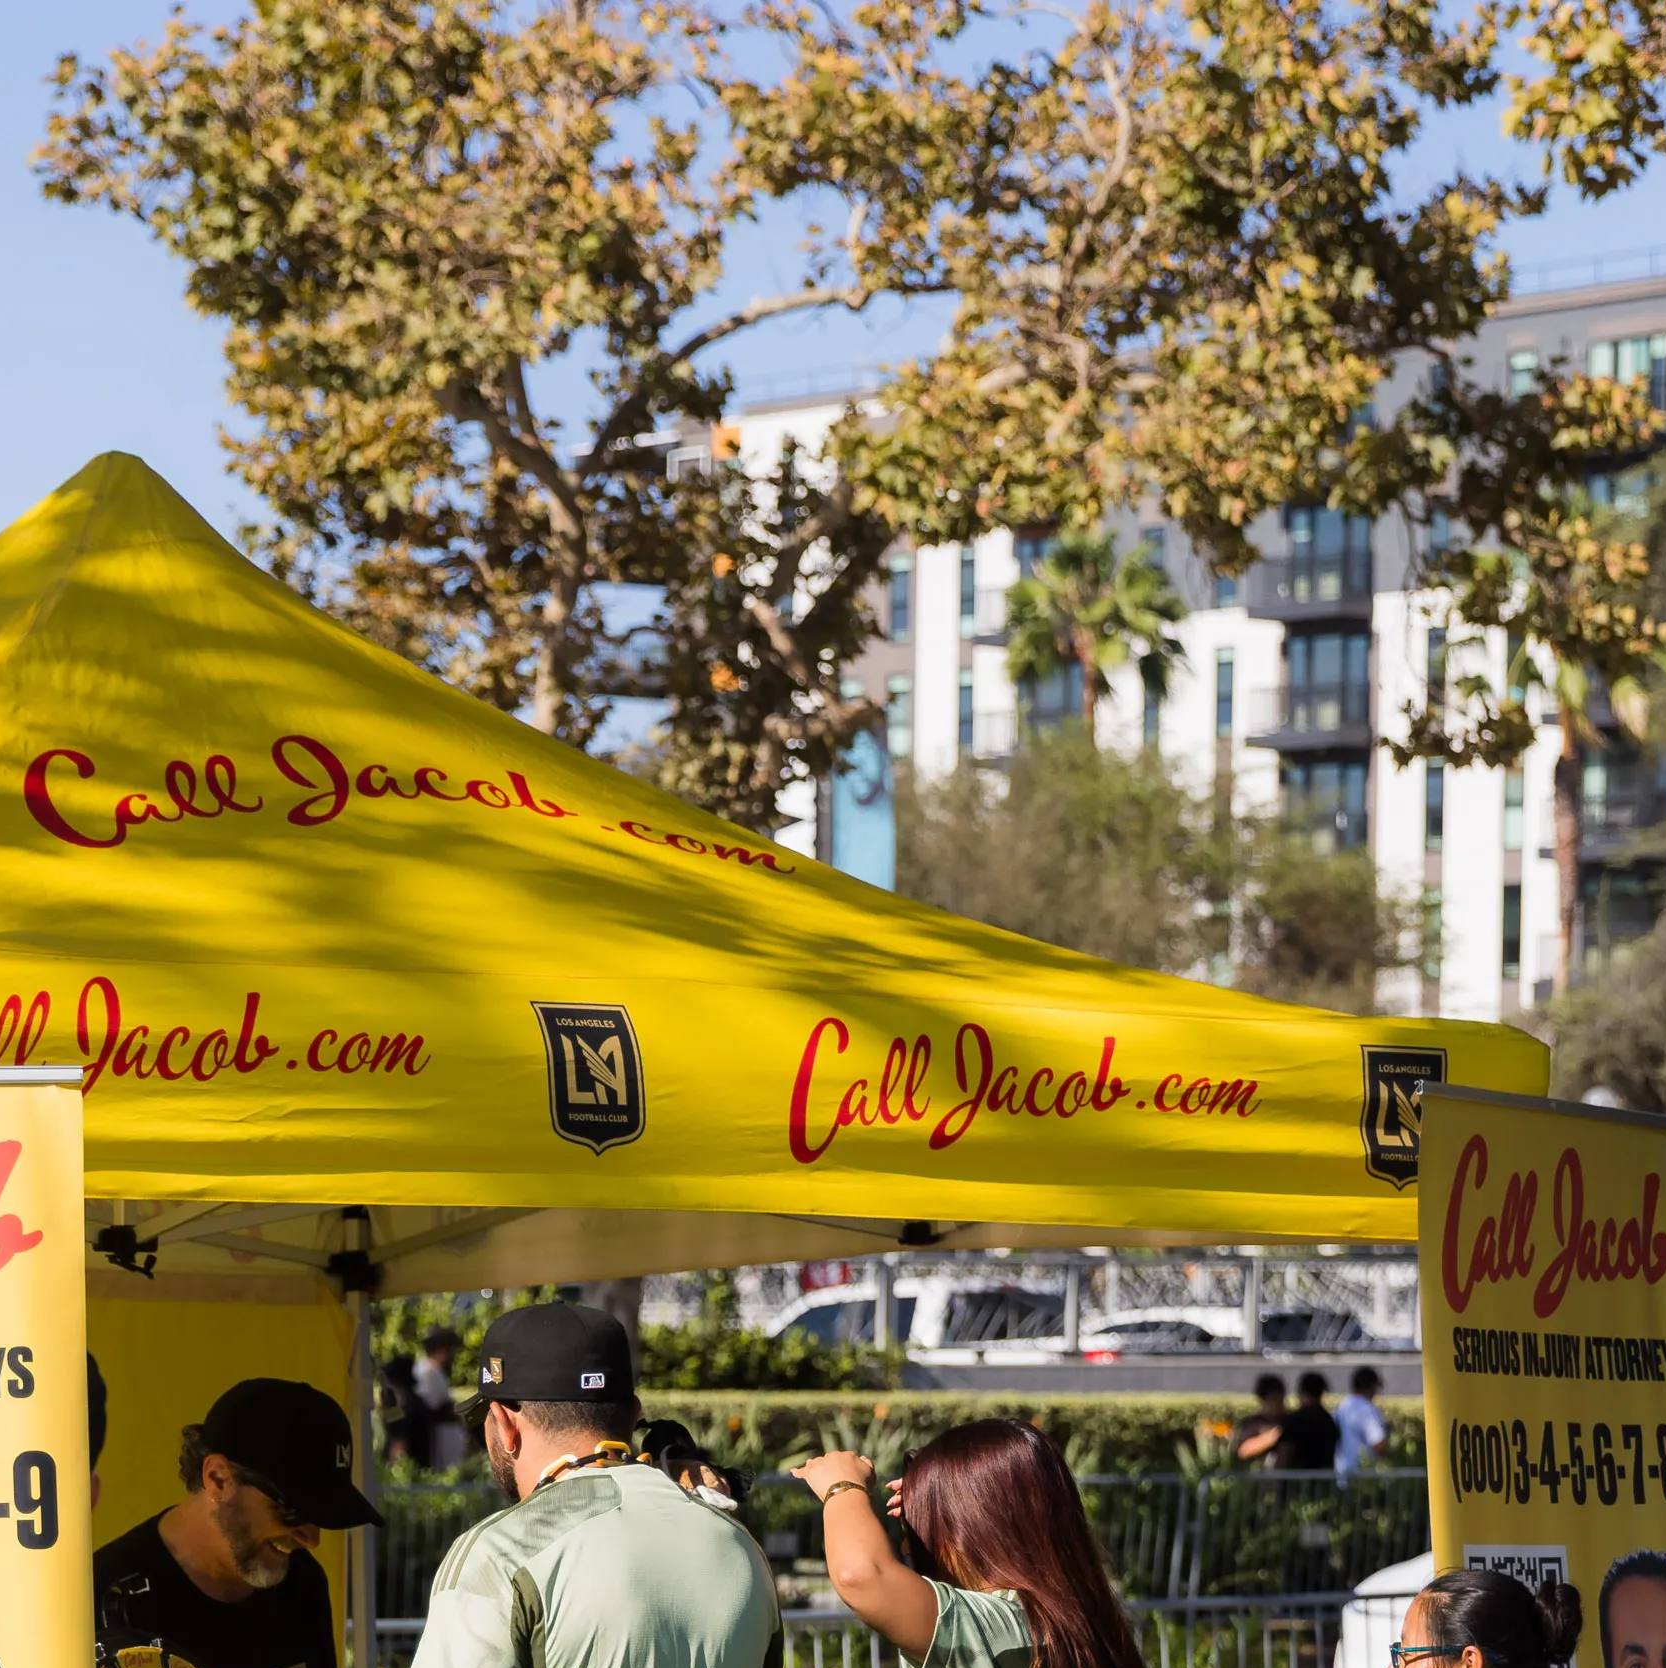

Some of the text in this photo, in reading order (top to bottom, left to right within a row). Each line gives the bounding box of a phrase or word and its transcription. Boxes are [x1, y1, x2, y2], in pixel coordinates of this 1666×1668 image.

[22, 748, 264, 850] Call
[574, 1017, 617, 1030] ANGELES
[788, 1015, 1262, 1165] Call Jacob.com
[1378, 1063, 1432, 1076] LOS ANGELES
[1441, 1133, 1539, 1314] Call
[1452, 1326, 1520, 1377] SERIOUS
[1522, 1331, 1581, 1379] INJURY
